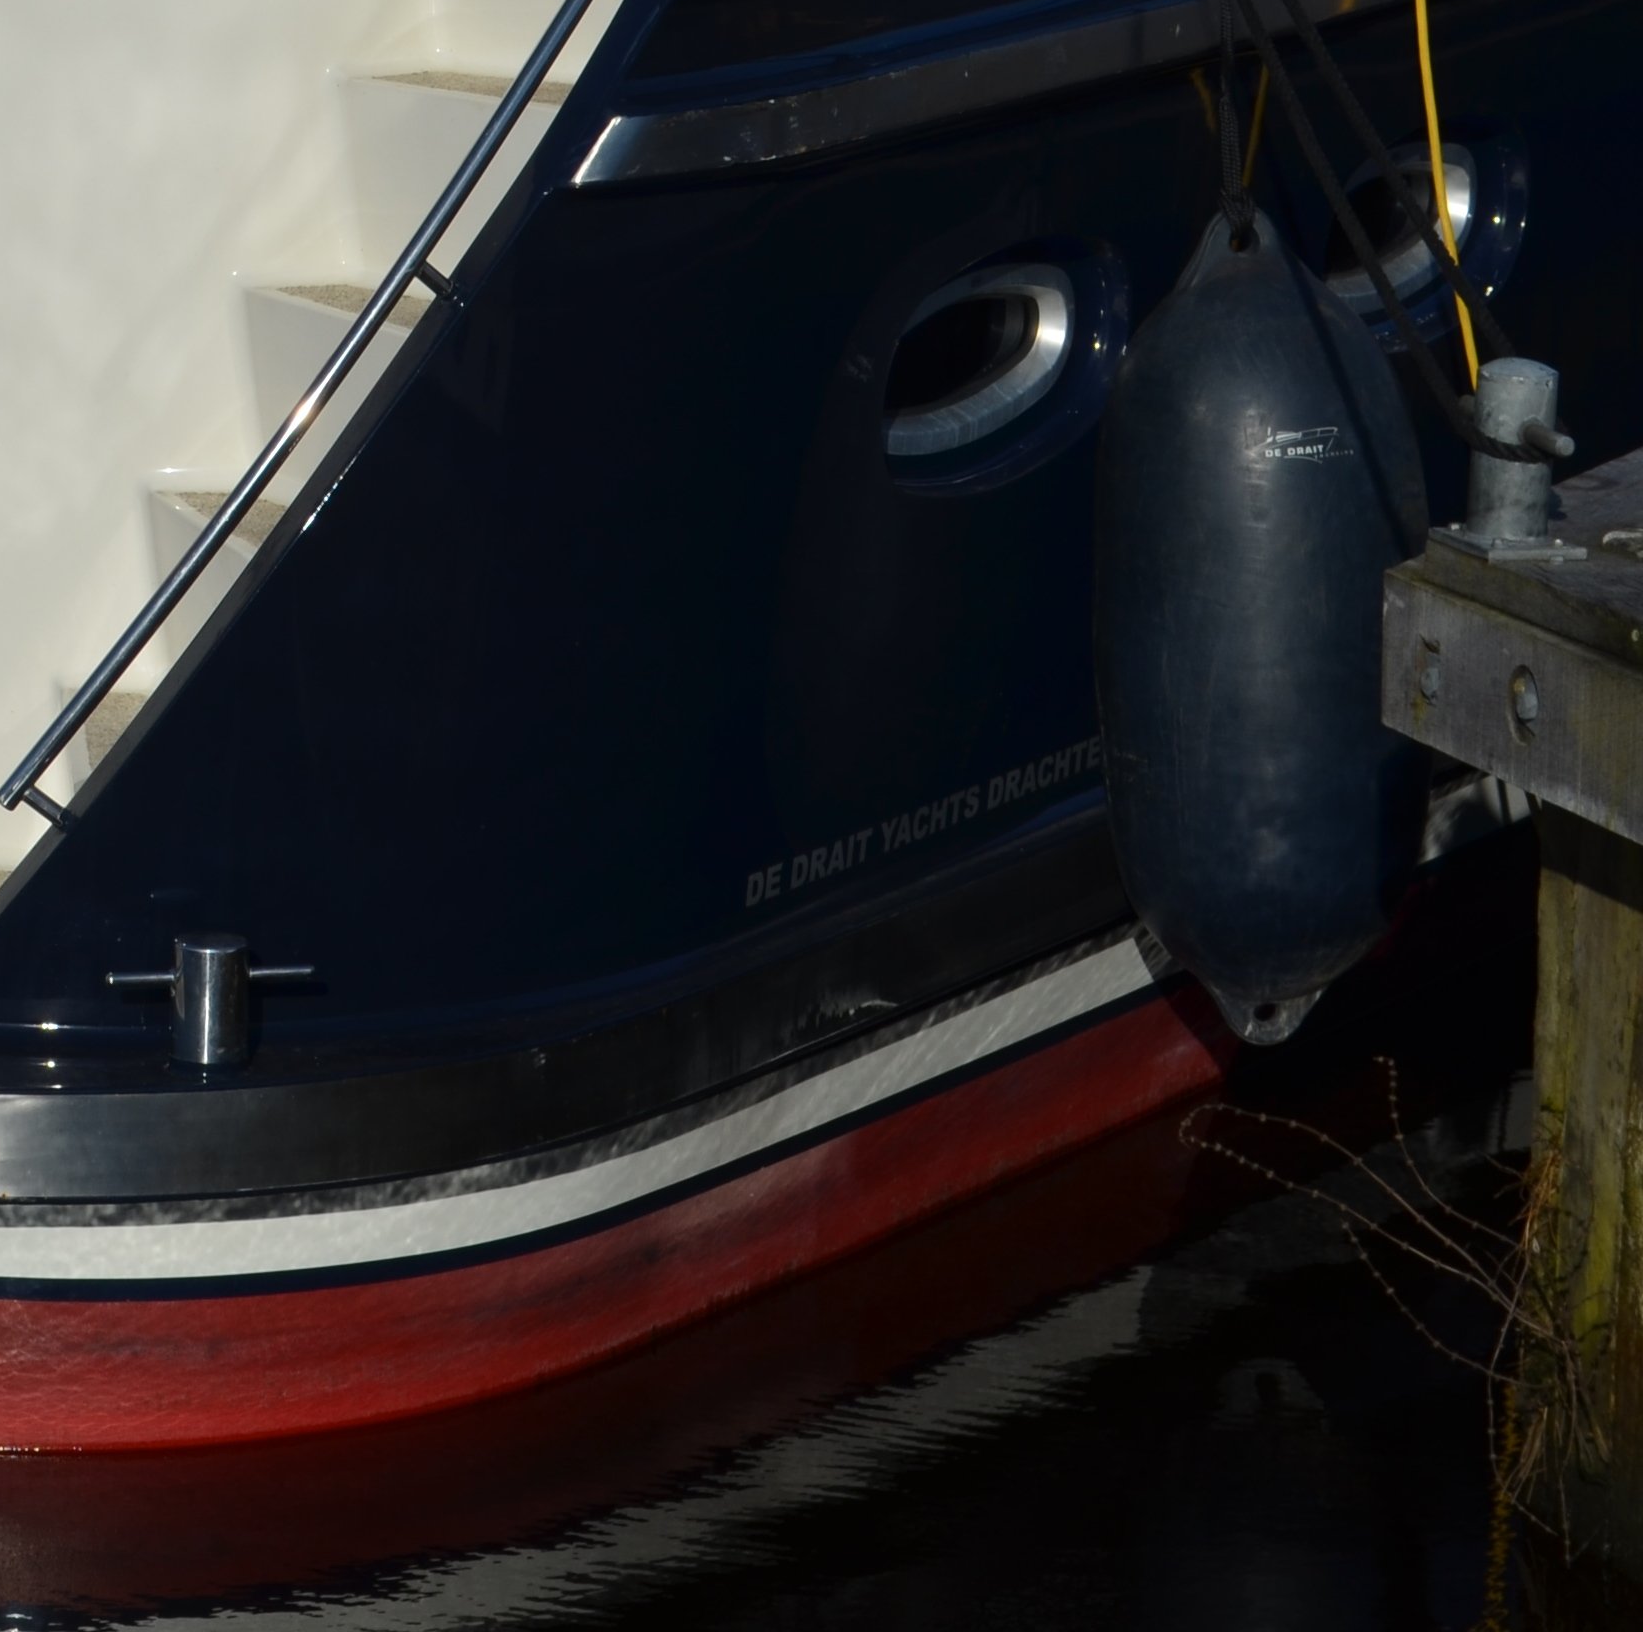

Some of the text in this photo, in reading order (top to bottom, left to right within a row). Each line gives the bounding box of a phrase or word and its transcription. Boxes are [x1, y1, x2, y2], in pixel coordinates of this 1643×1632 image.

[1286, 445, 1323, 456] DRAIT
[745, 734, 1102, 908] DE DRAIT YACHTS DRACHTE
